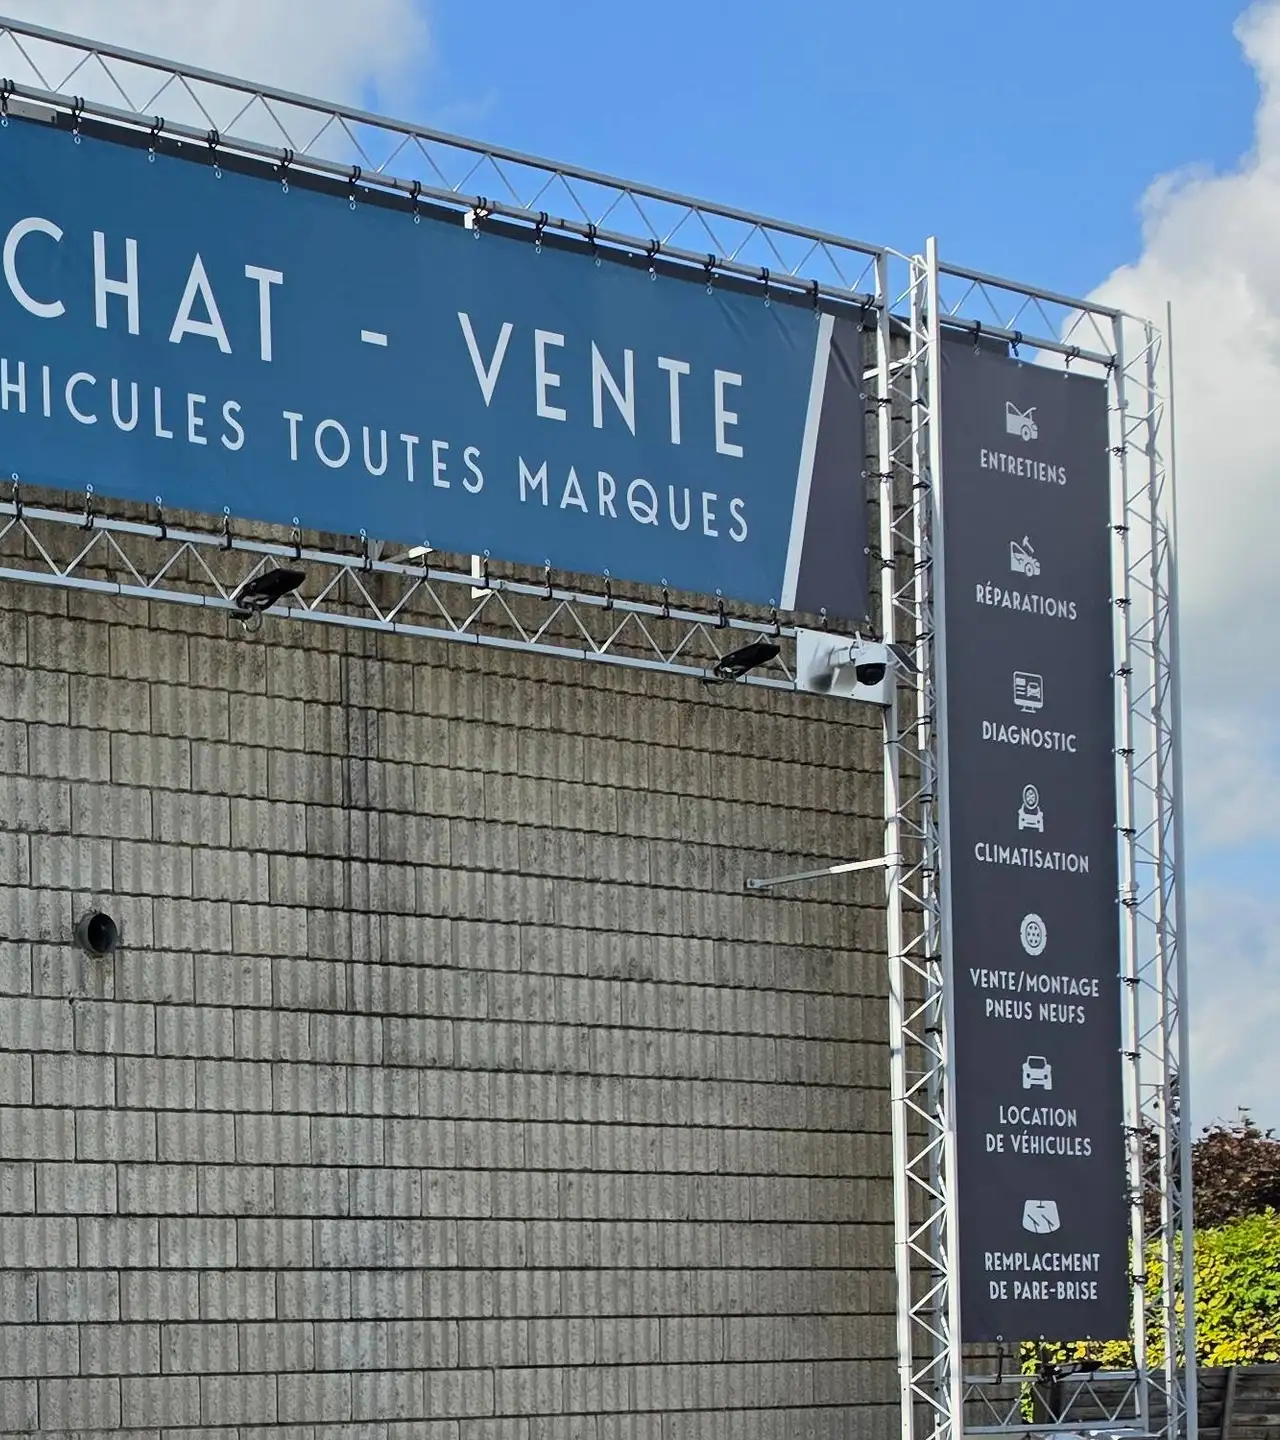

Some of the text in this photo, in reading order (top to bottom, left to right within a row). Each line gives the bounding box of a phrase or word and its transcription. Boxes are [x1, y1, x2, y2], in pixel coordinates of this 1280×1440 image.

[360, 329, 388, 346] -
[457, 311, 745, 459] VENTE
[283, 411, 485, 494] TOUTES
[519, 456, 749, 544] MARQUES
[980, 448, 1067, 486] ENTRETIENS
[975, 580, 1077, 620] RÉPARATIONS
[982, 720, 1077, 753] DIAGNOSTIC
[974, 842, 1089, 873] CLIMATISATION
[970, 968, 1100, 998] VENTE/MONTAGE
[985, 998, 1086, 1024] PNEUS NEUFS
[999, 1105, 1077, 1127] LOCATION
[986, 1130, 1092, 1156] DE VÉHICULES
[984, 1252, 1100, 1273] REMPLACEMENT
[989, 1280, 1098, 1301] DE PARE-BRISE
